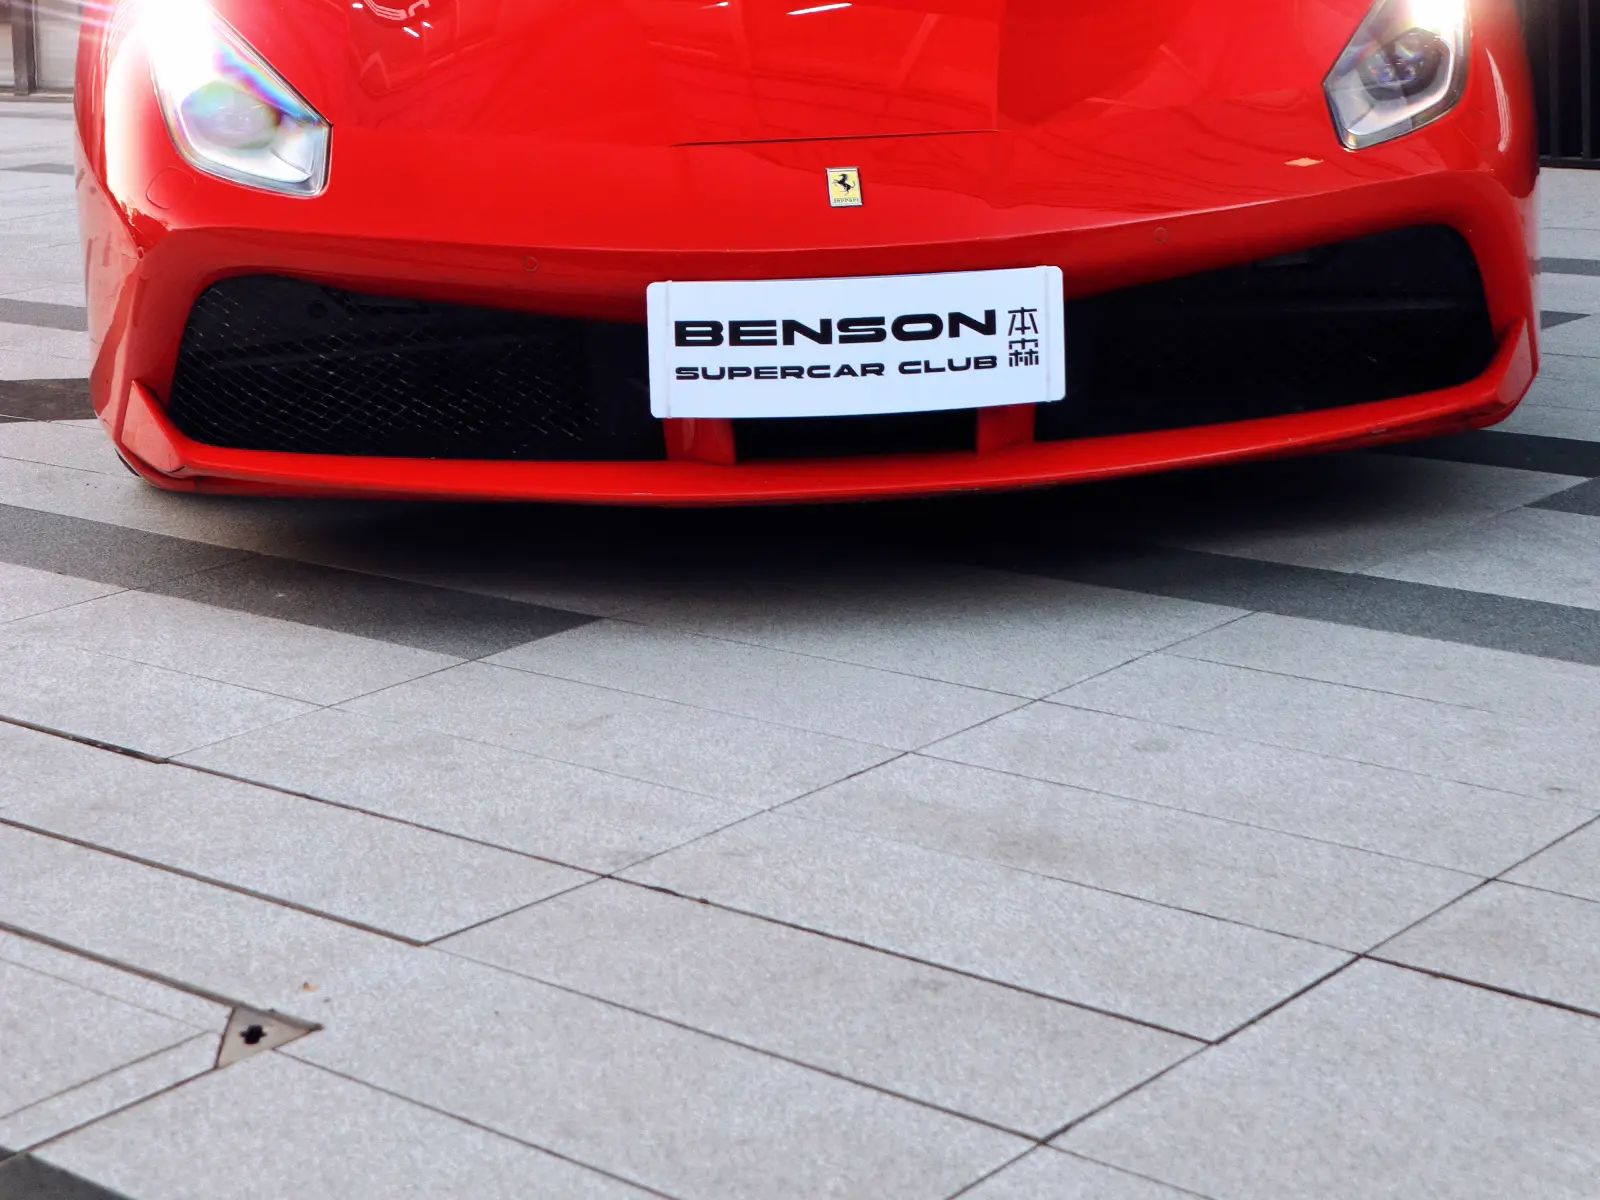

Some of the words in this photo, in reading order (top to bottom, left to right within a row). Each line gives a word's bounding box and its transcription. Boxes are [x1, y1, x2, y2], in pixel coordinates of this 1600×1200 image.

[674, 309, 997, 347] BENSON
[675, 362, 885, 381] SUPERCAR
[898, 356, 998, 375] CLUB
